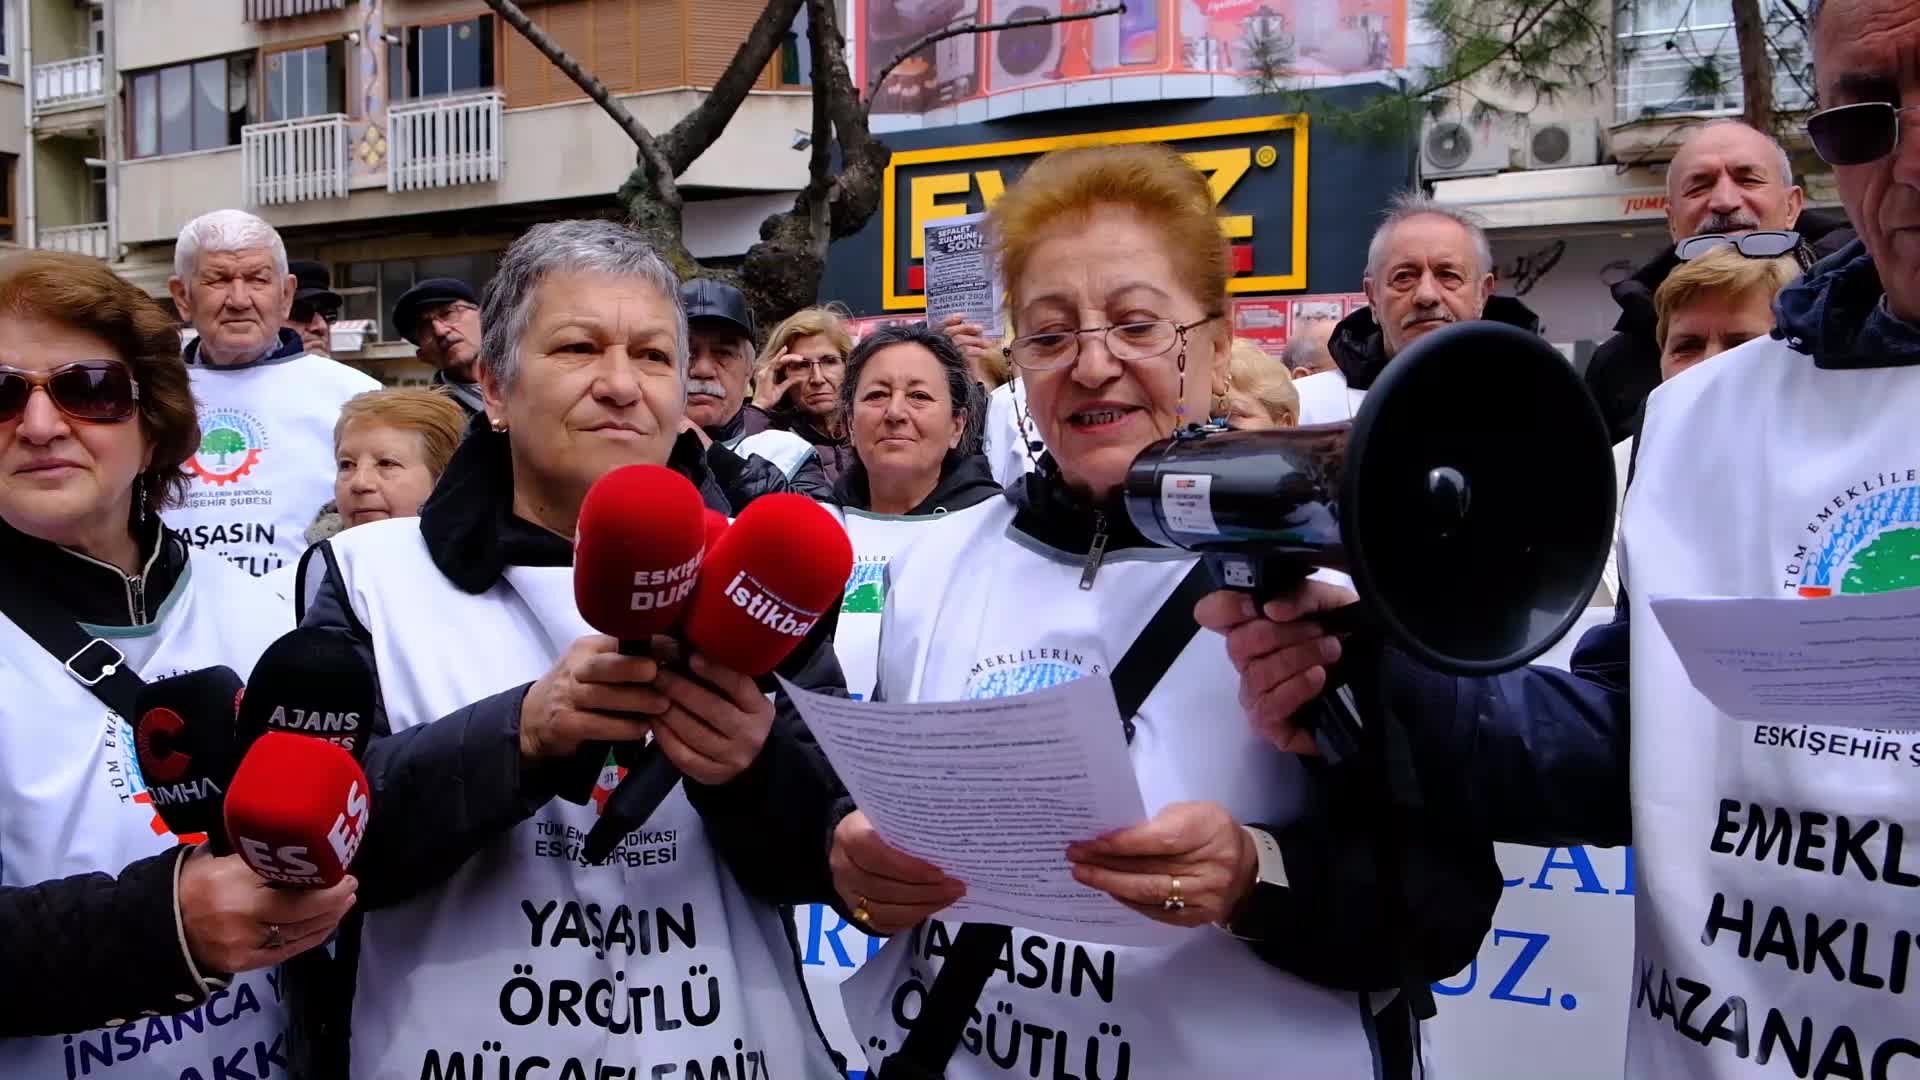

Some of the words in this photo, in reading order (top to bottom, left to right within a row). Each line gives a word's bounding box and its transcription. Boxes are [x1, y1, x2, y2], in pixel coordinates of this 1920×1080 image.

[938, 225, 971, 238] SEFALET
[938, 232, 977, 245] ZULMÜNE
[947, 235, 983, 253] SON!
[230, 496, 273, 507] ŞUBESİ
[1783, 544, 1808, 589] TÜM
[1805, 469, 1920, 535] EMEKLİLE
[268, 705, 361, 732] AJANS
[1754, 724, 1902, 762] ESKİŞEHİR
[536, 820, 563, 836] TÜM
[1710, 797, 1920, 888] EMEKL
[239, 836, 319, 877] ES
[627, 844, 677, 868] BESİ
[520, 899, 697, 960] YAŞASIN
[1700, 892, 1920, 994] HAKLI
[499, 962, 722, 1035] ÖRGÜTLÜ
